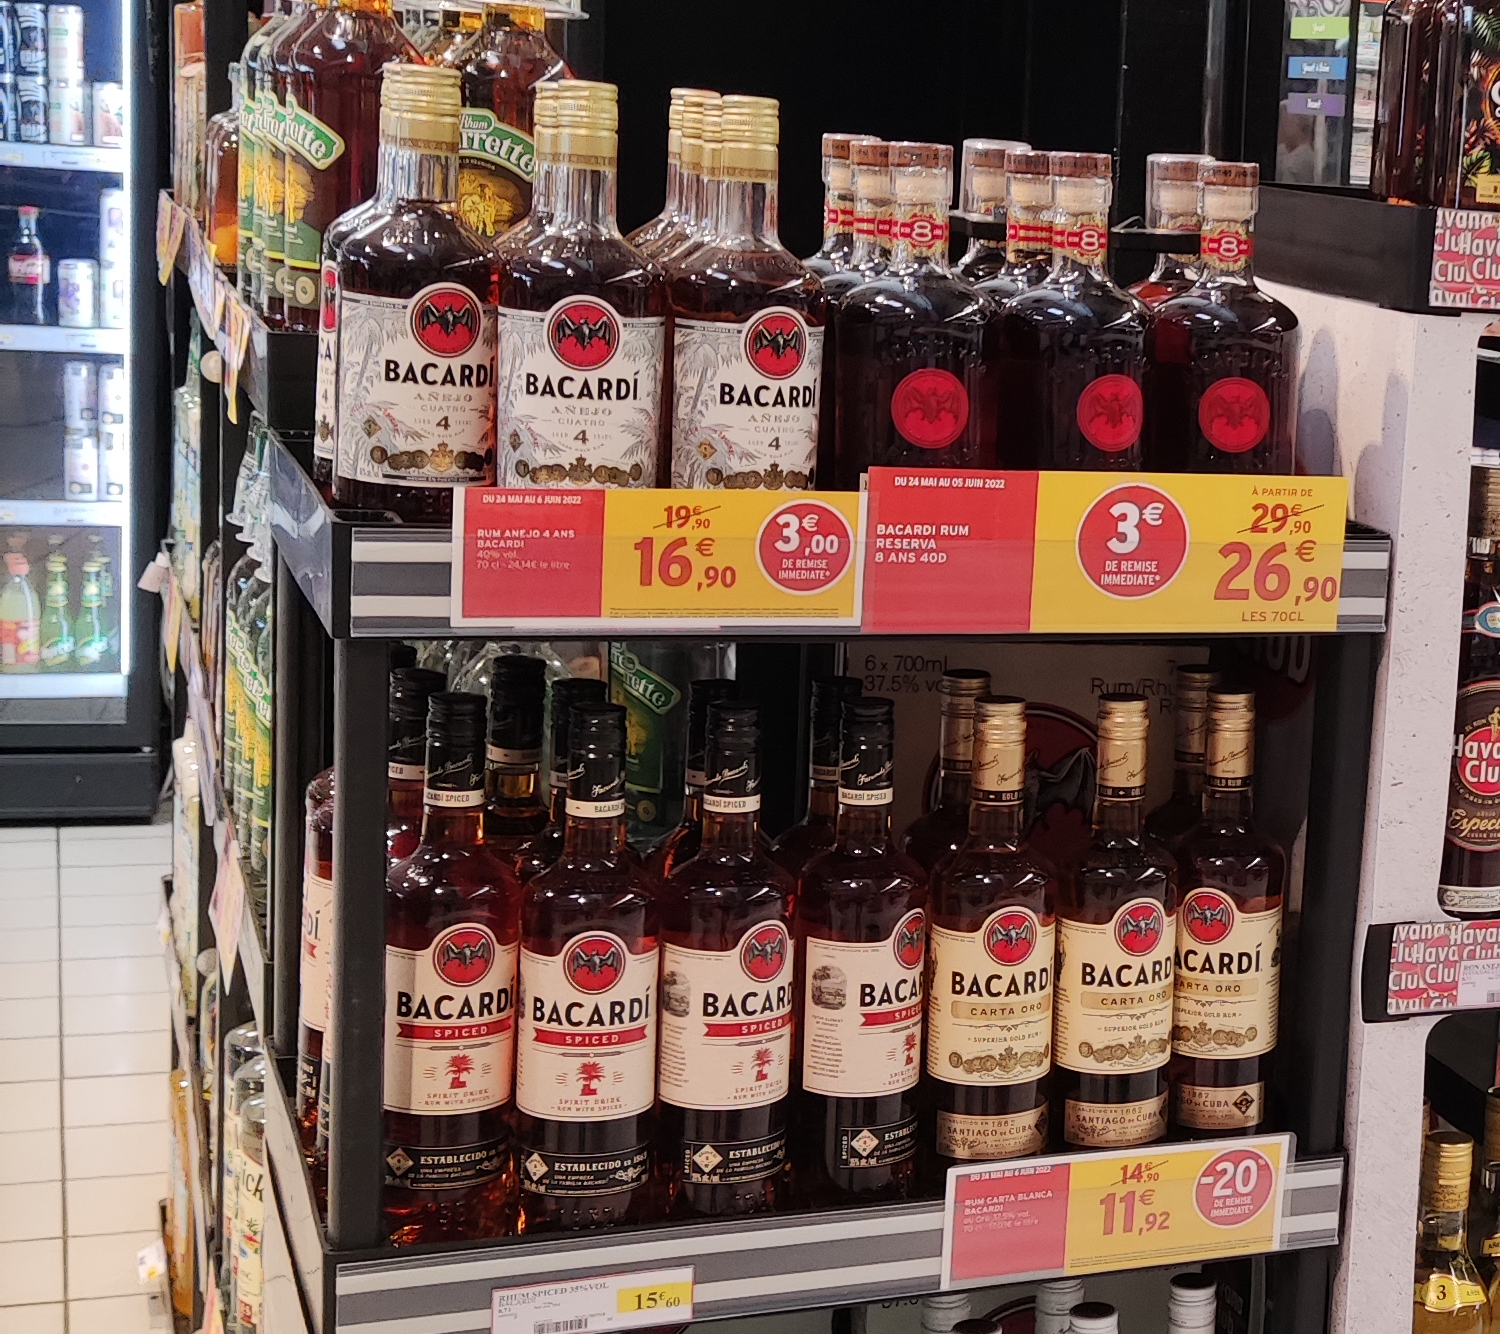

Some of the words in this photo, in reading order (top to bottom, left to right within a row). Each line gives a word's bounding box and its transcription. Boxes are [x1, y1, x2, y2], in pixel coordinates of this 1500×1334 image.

[384, 356, 493, 388] BACARDÍ
[526, 370, 641, 402] BACARDÍ
[719, 379, 817, 409] BACARDÍ
[894, 477, 906, 488] DU
[908, 477, 920, 488] 24
[923, 477, 937, 488] MAI
[939, 478, 950, 488] AU
[965, 478, 983, 489] JUIN
[984, 479, 1005, 489] 2022
[1262, 487, 1298, 497] PARTIR
[1300, 488, 1313, 497] DE
[477, 529, 500, 539] RUM
[543, 530, 550, 539] 4
[553, 529, 575, 539] ANS
[876, 524, 937, 536] BACARDI
[940, 524, 970, 536] RUM
[477, 540, 524, 549] BACARDI
[875, 538, 937, 550] RESERVA
[875, 552, 884, 563] 8
[887, 552, 917, 563] ANS
[782, 559, 792, 569] DE
[794, 559, 828, 569] REMISE
[1105, 561, 1119, 572] DE
[1121, 561, 1158, 573] REMISE
[1241, 611, 1268, 622] LES
[1271, 611, 1305, 622] 70CL
[533, 985, 651, 1028] BACARDÍ
[970, 1007, 1016, 1016] CARTA
[1020, 1002, 1042, 1013] ORO
[565, 1034, 619, 1044] SPICED
[554, 1159, 621, 1172] ESTABLECIDO
[1214, 1199, 1223, 1207] DE
[1225, 1196, 1252, 1206] REMISE
